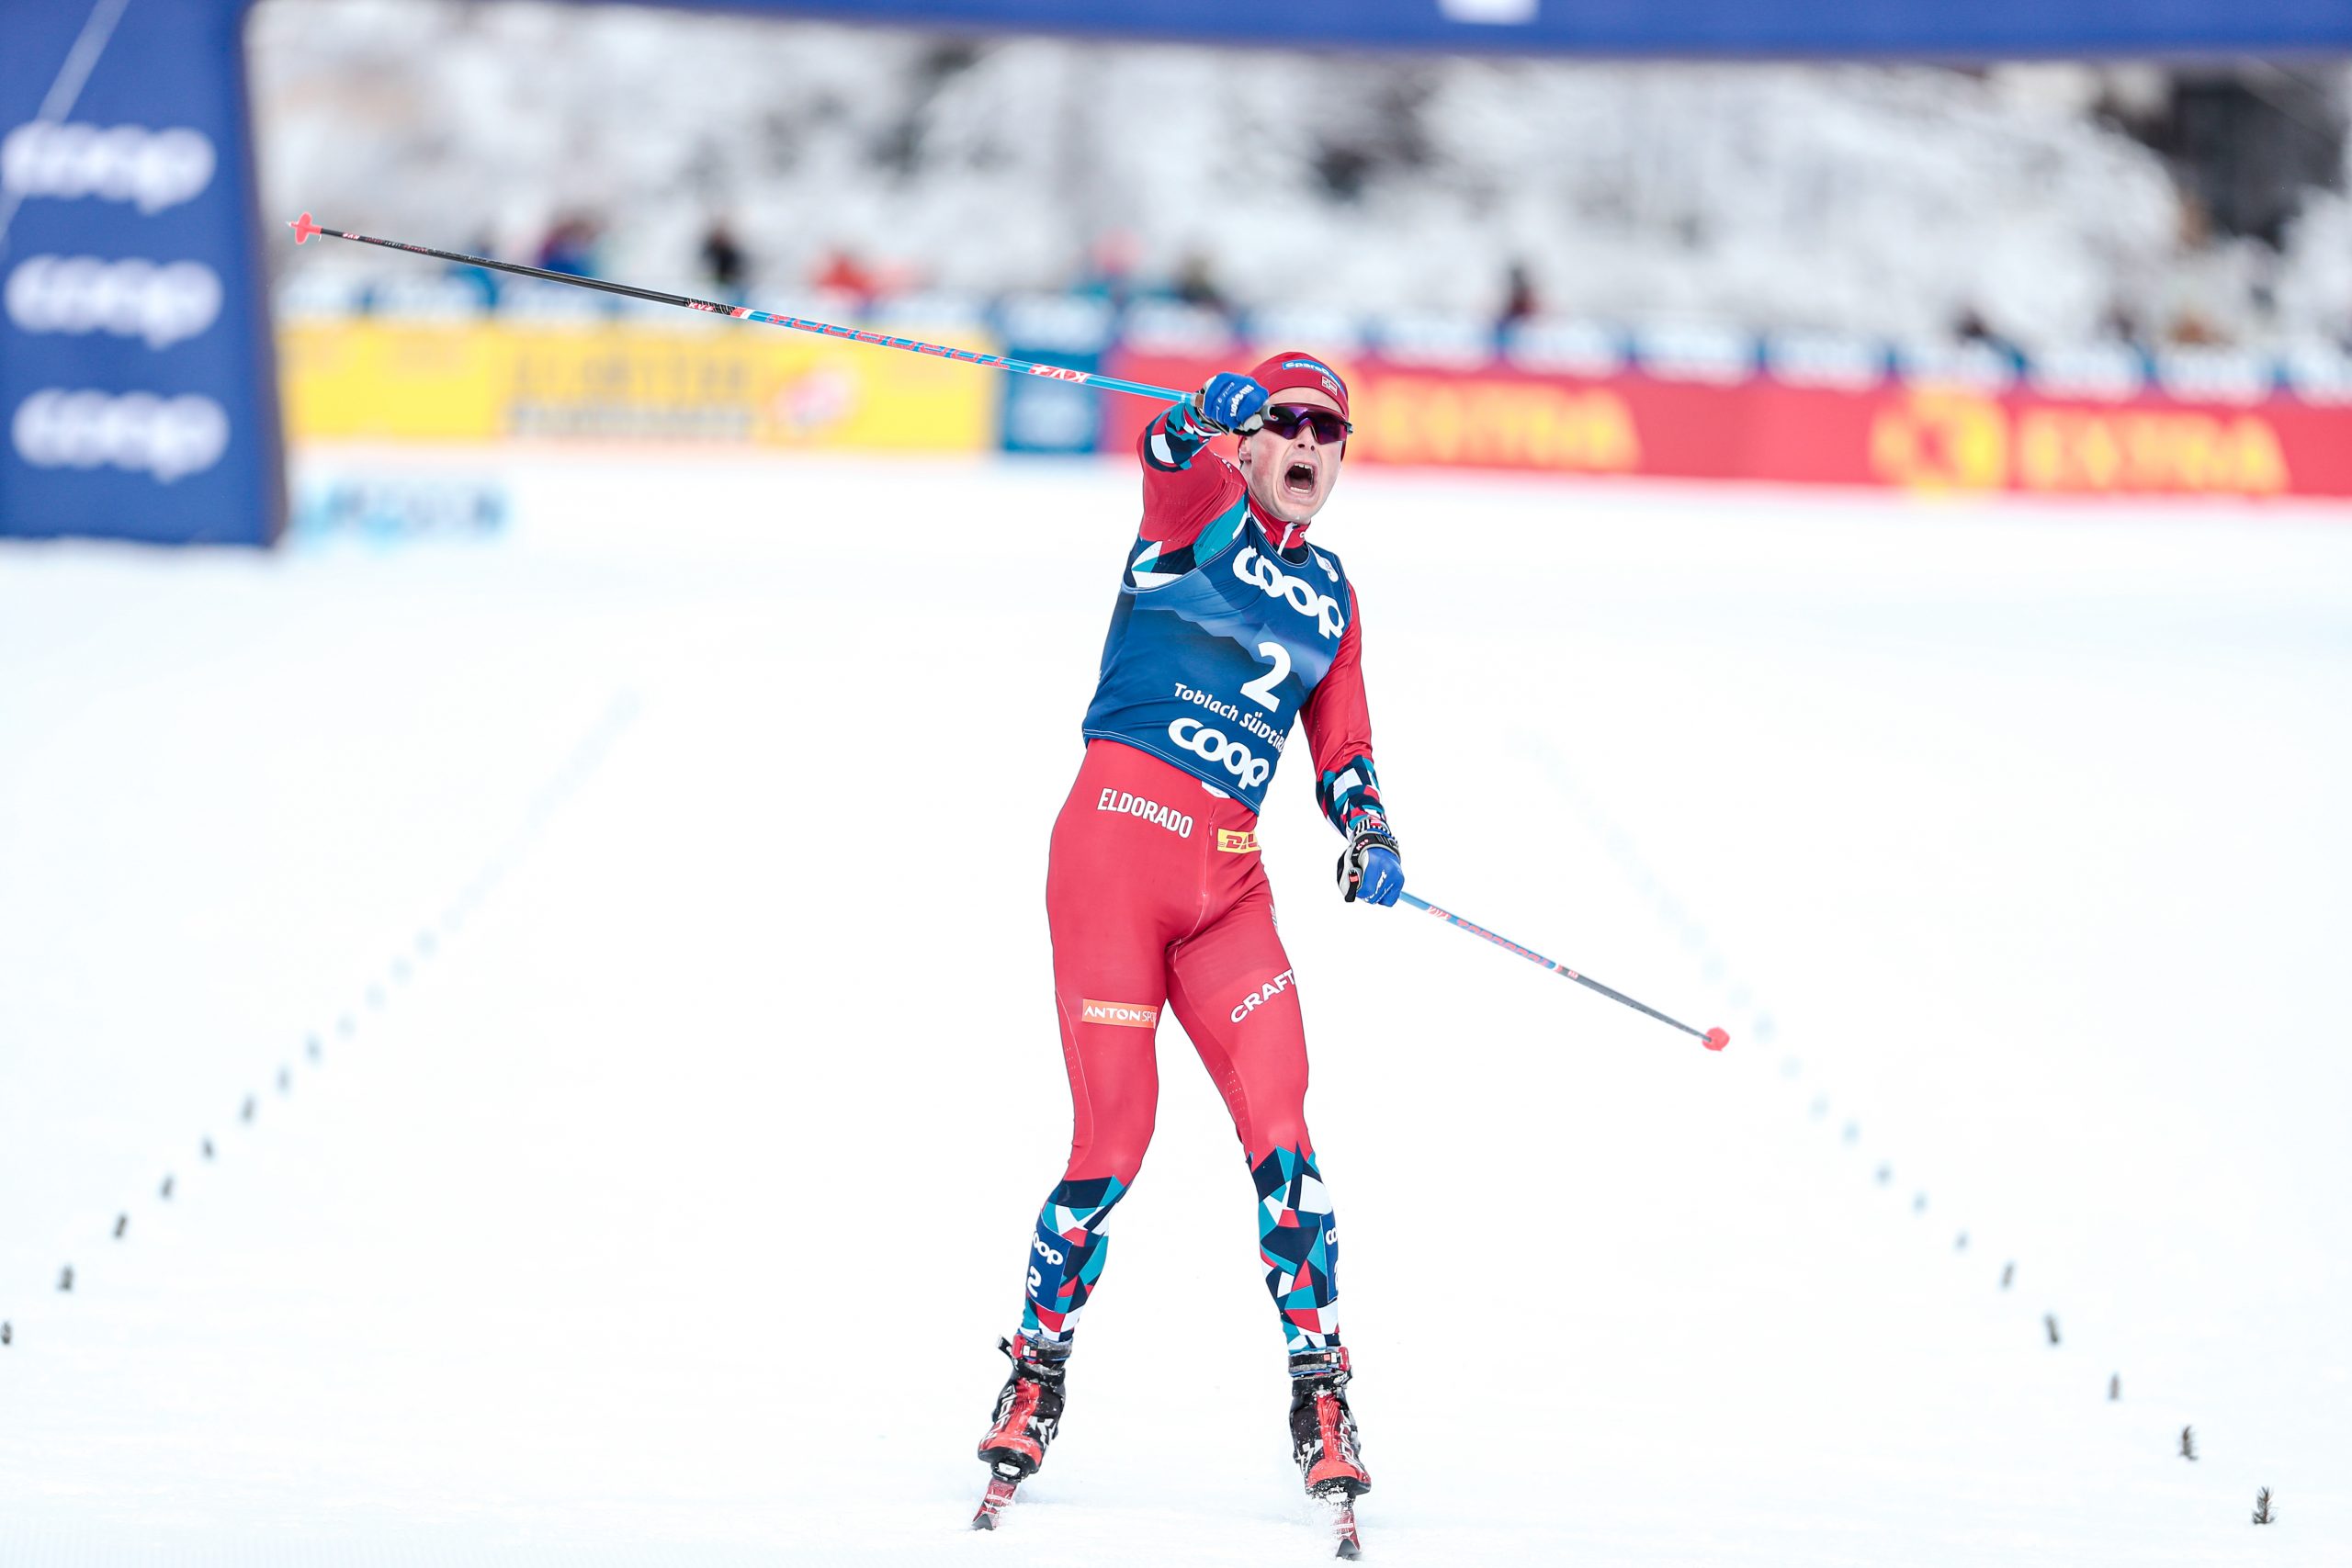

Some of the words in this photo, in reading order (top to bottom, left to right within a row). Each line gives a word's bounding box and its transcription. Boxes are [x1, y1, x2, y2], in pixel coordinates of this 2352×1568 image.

[1232, 546, 1346, 640] coop
[1174, 682, 1239, 722] Toblach
[1239, 641, 1292, 713] 2
[1168, 717, 1270, 790] coop
[1097, 787, 1194, 839] ELDORADO
[1230, 968, 1295, 1023] CRAFT
[1033, 1232, 1064, 1265] oop
[1027, 1266, 1042, 1298] 2
